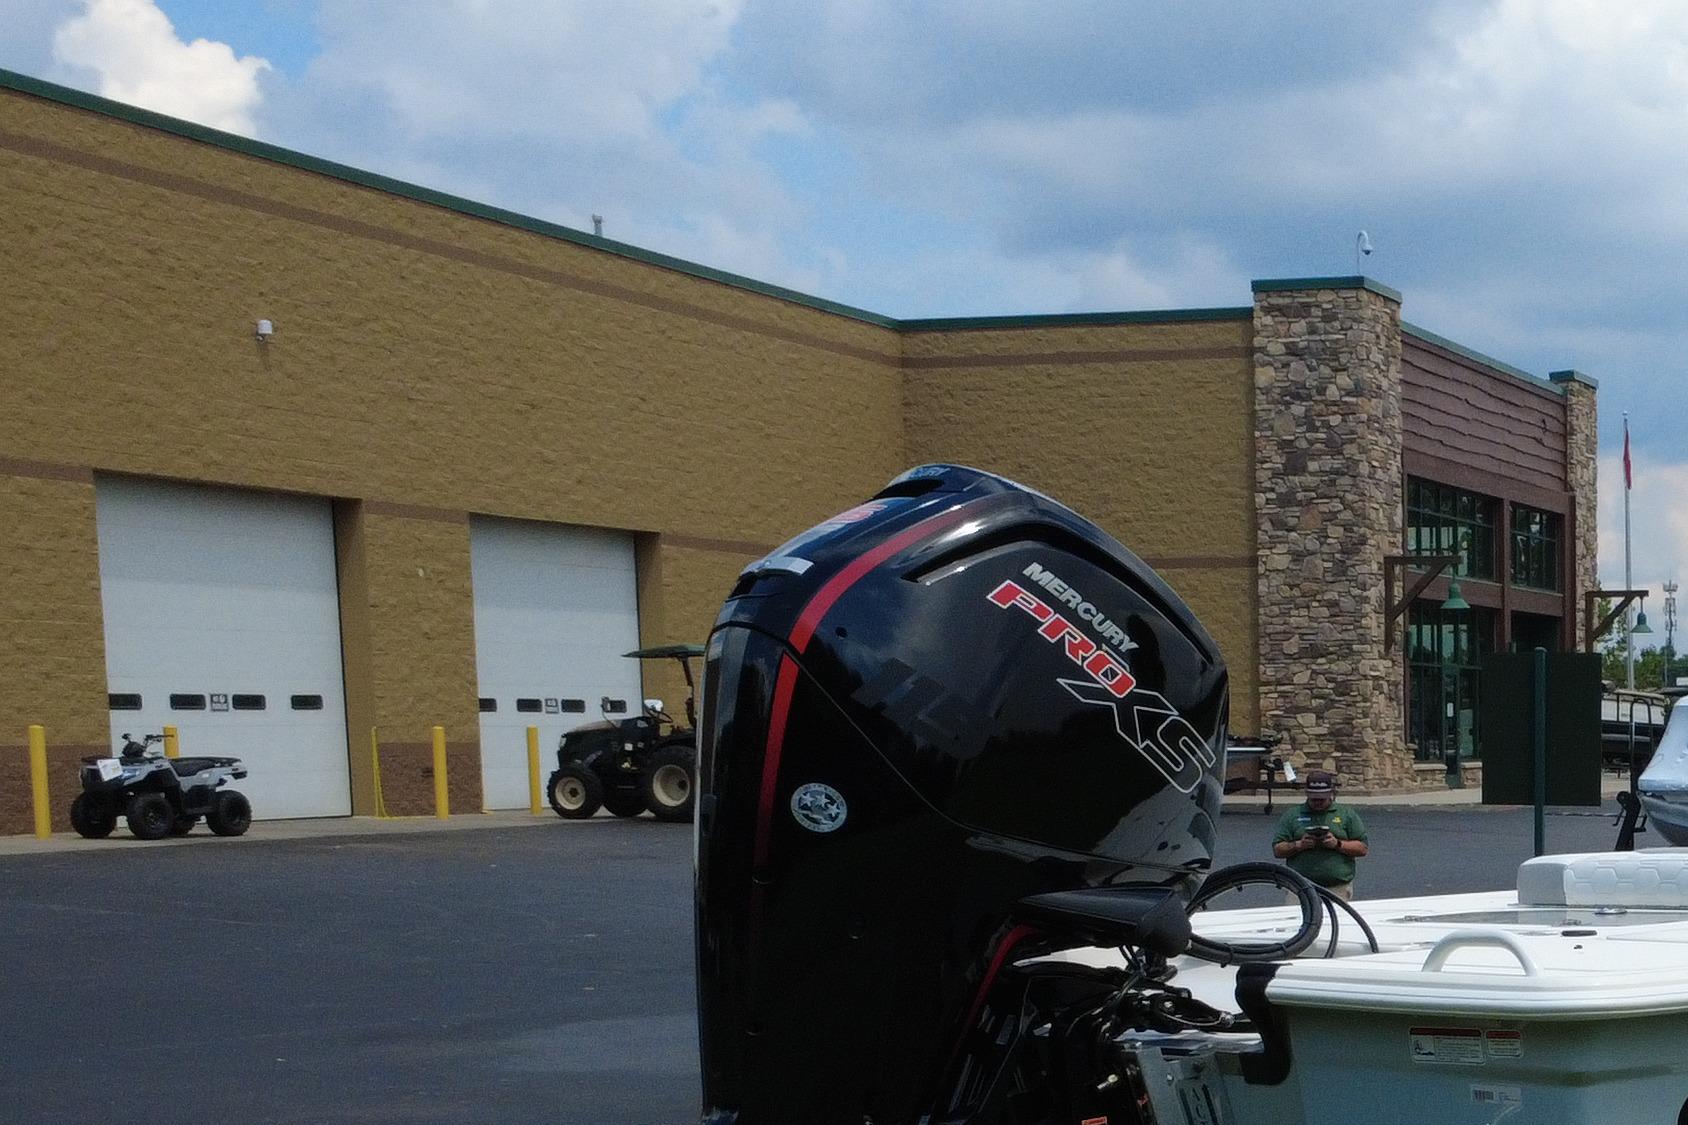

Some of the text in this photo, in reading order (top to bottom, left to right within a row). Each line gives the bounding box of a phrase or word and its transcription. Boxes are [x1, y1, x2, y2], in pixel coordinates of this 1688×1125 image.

[1022, 562, 1139, 653] MERCURY
[986, 579, 1217, 794] PRO XS
